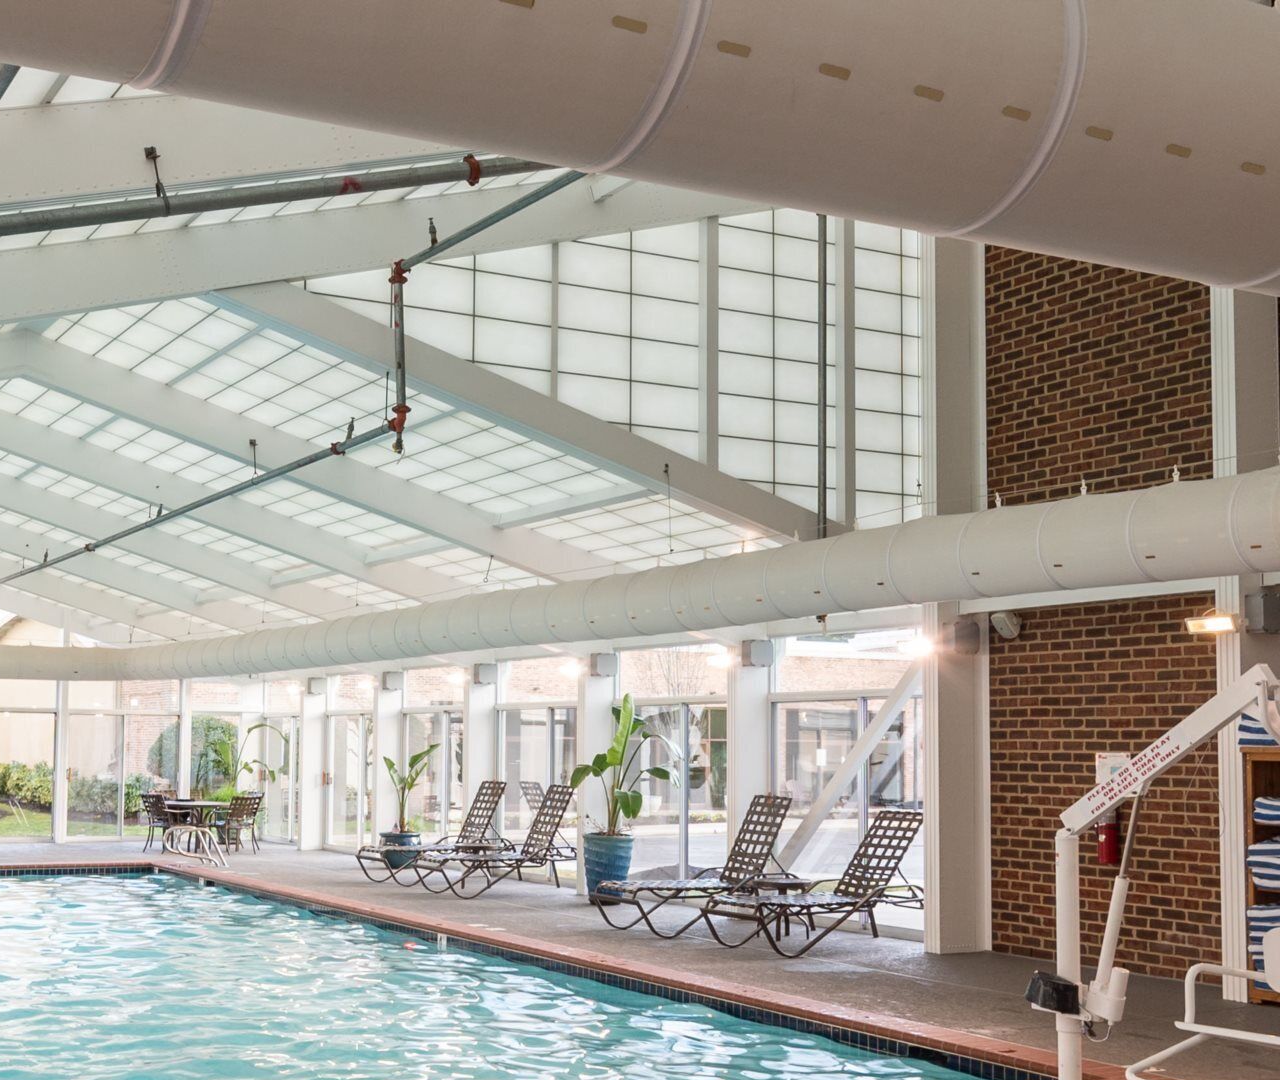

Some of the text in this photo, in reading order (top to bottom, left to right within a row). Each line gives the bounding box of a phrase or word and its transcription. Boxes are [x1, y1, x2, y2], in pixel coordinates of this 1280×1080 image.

[1087, 735, 1171, 802] PLEASE DO NOT PLAY
[1091, 745, 1181, 815] FOR NEEDED USE ONLY
[1103, 752, 1161, 797] ON LIFT CHAIR
